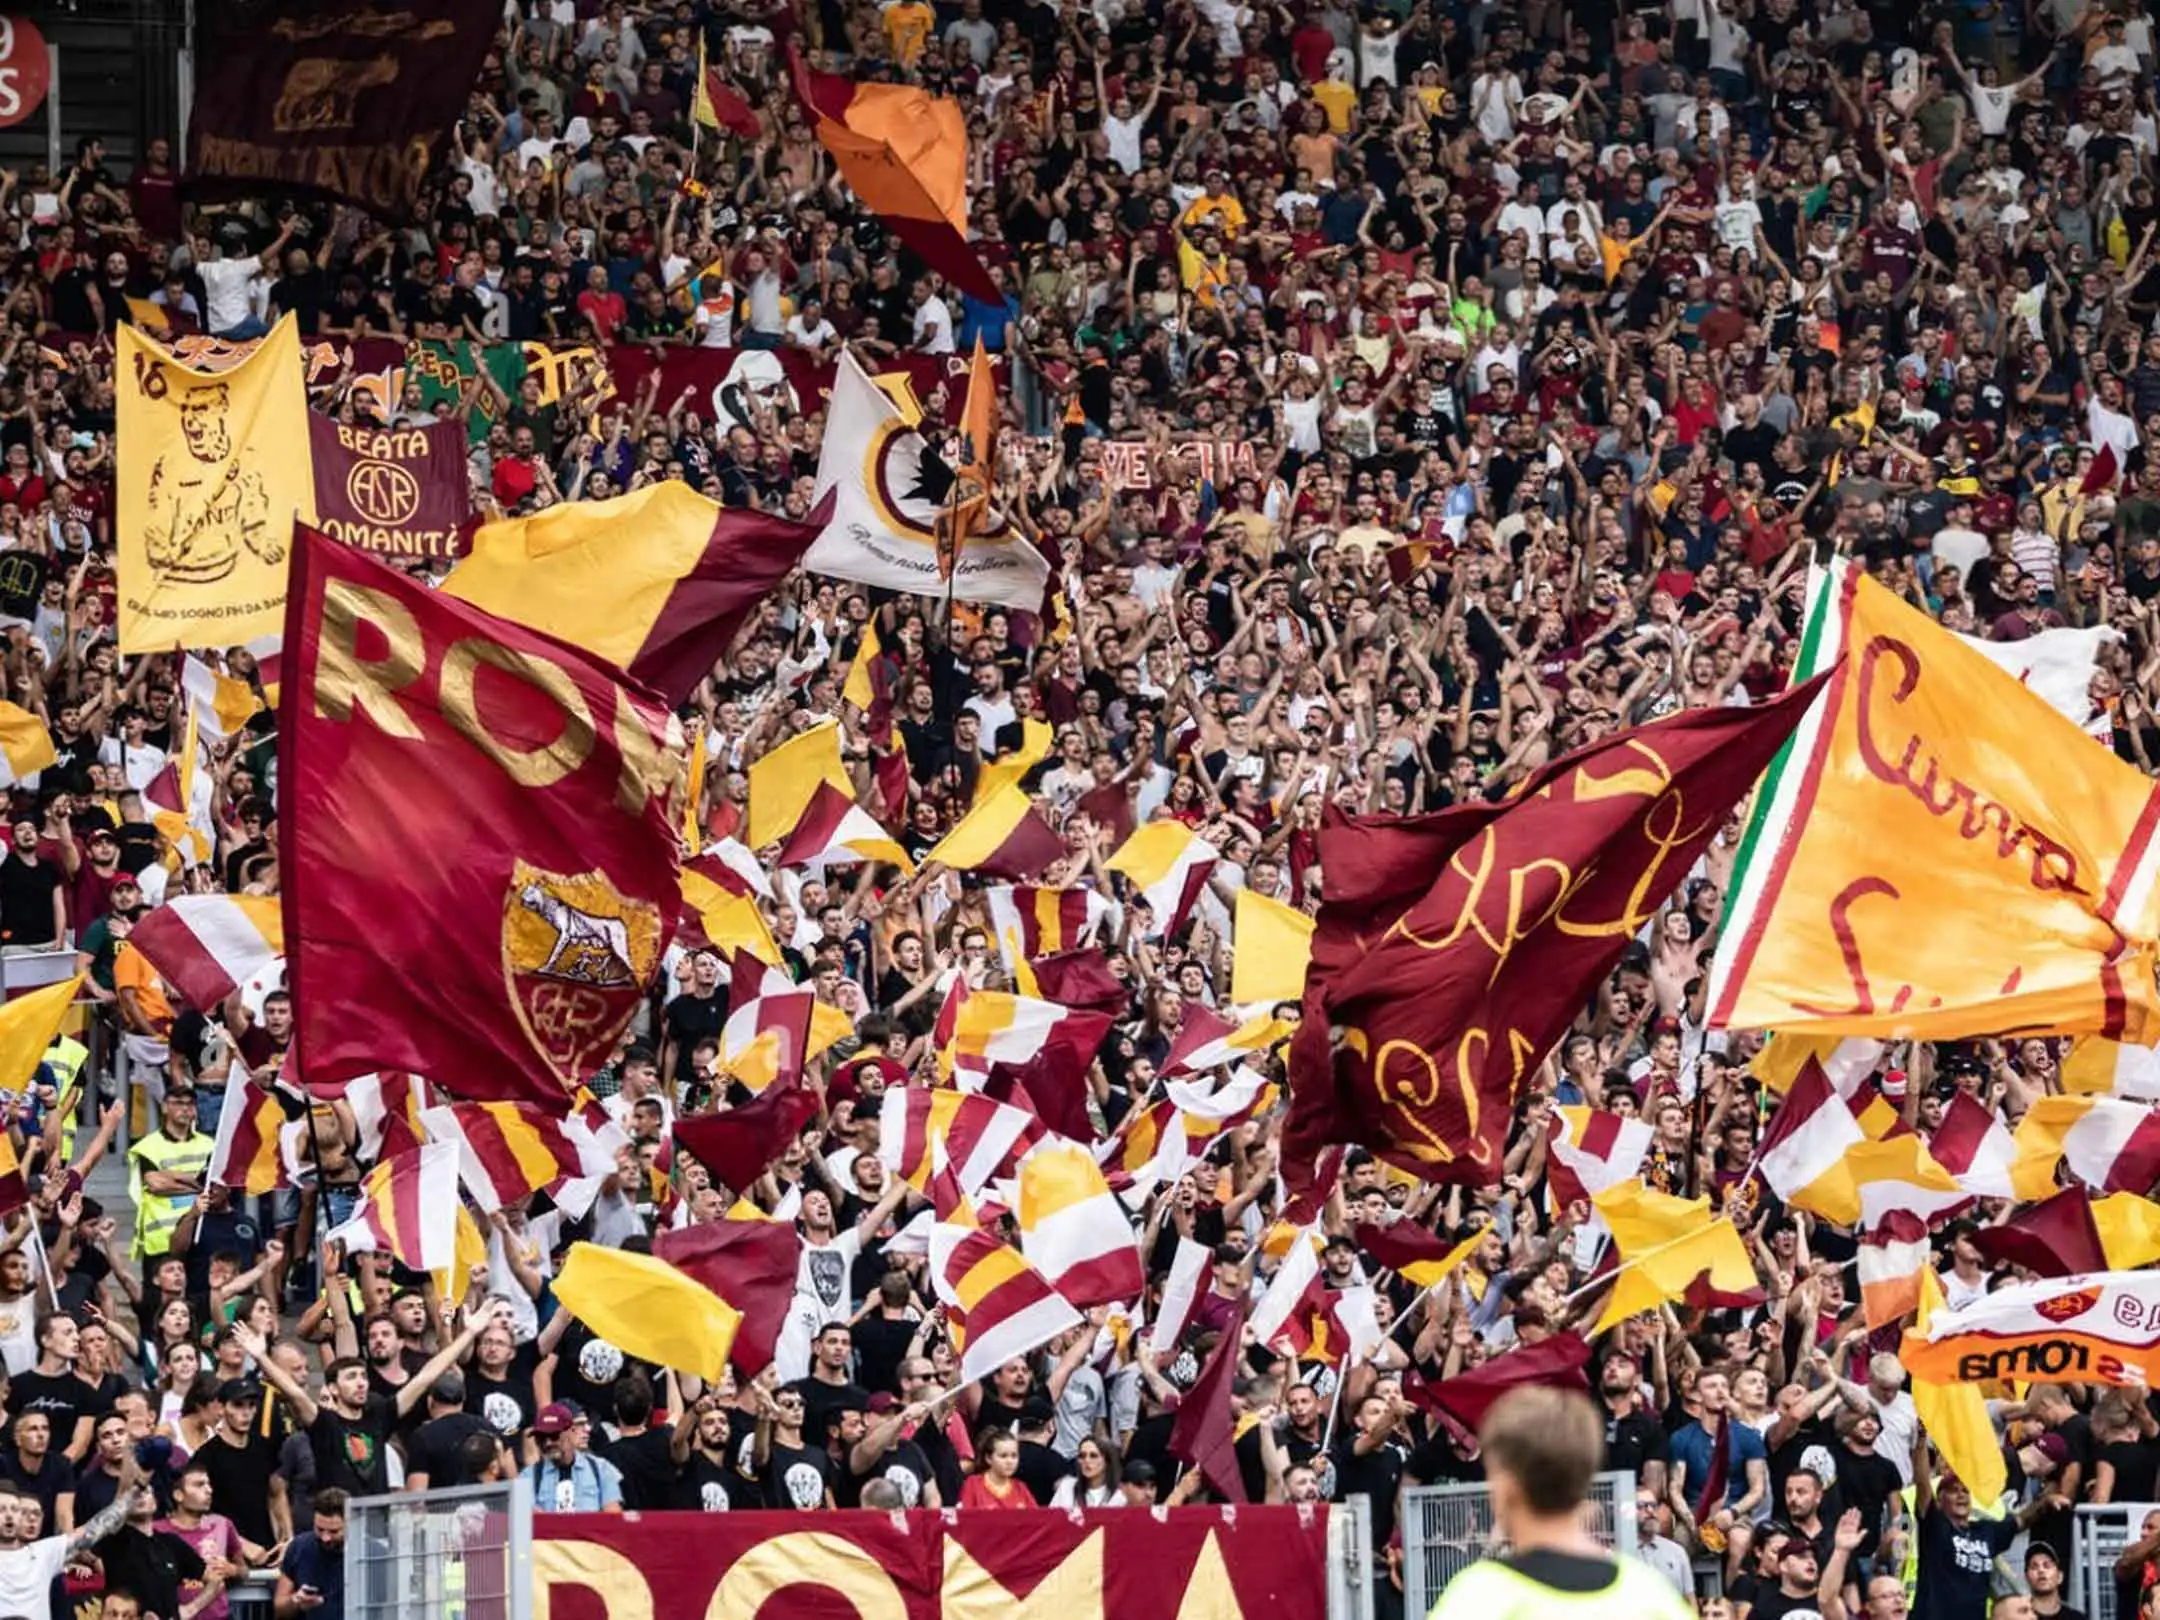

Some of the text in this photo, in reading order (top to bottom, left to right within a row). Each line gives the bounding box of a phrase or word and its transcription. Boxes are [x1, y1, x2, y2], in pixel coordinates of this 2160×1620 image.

[134, 352, 167, 400] 16
[338, 425, 429, 459] BEATA
[353, 466, 412, 518] ASR
[311, 518, 460, 556] OMANIT
[895, 559, 941, 573] nostr
[181, 608, 223, 619] SOGNO
[247, 603, 262, 614] DA
